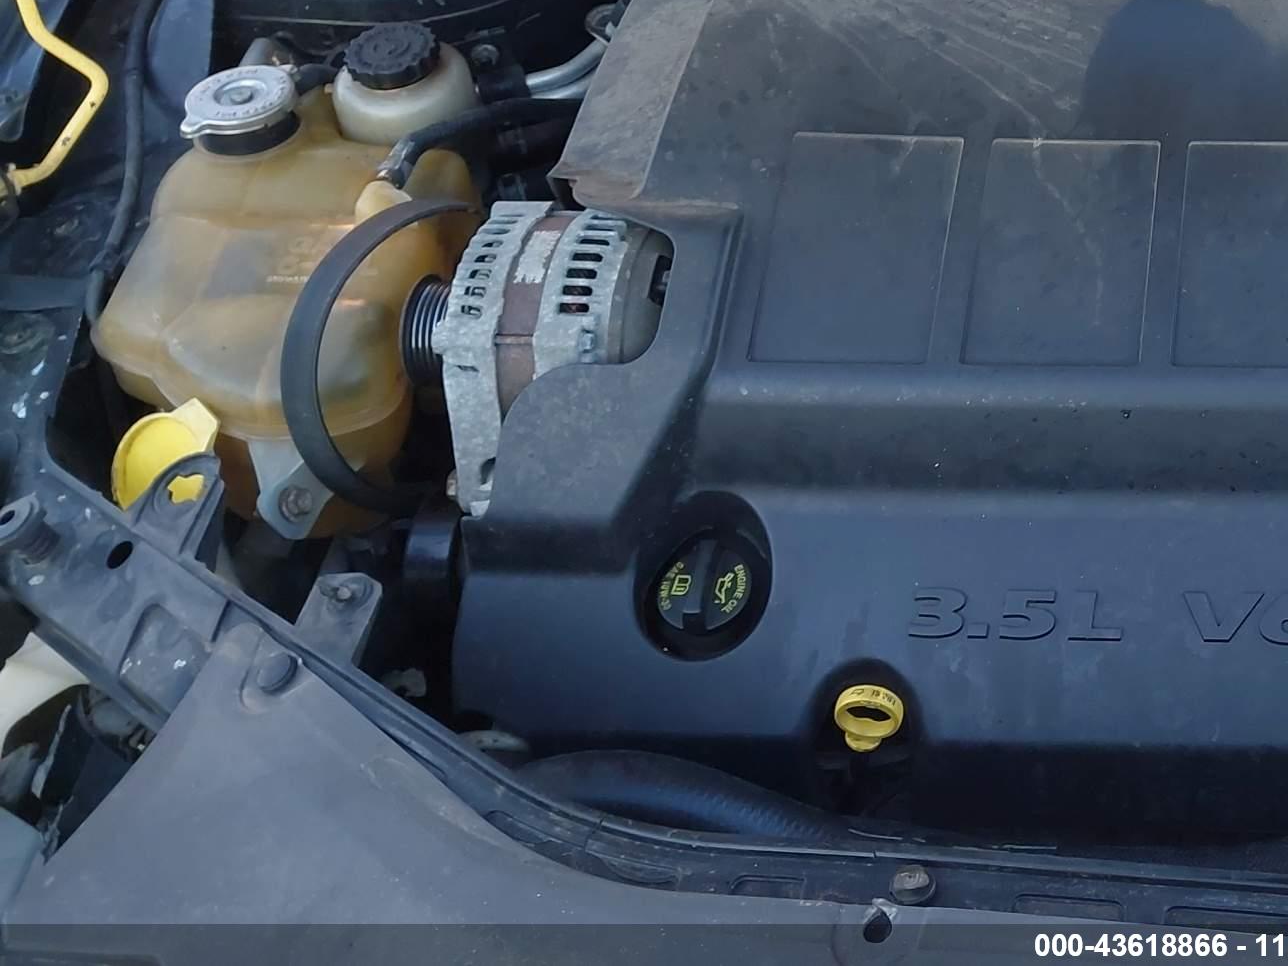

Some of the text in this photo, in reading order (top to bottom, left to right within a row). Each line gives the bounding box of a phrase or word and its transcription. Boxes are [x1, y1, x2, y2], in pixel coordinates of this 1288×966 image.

[720, 564, 746, 613] ENGINE OIL
[908, 587, 1123, 641] 3.5L
